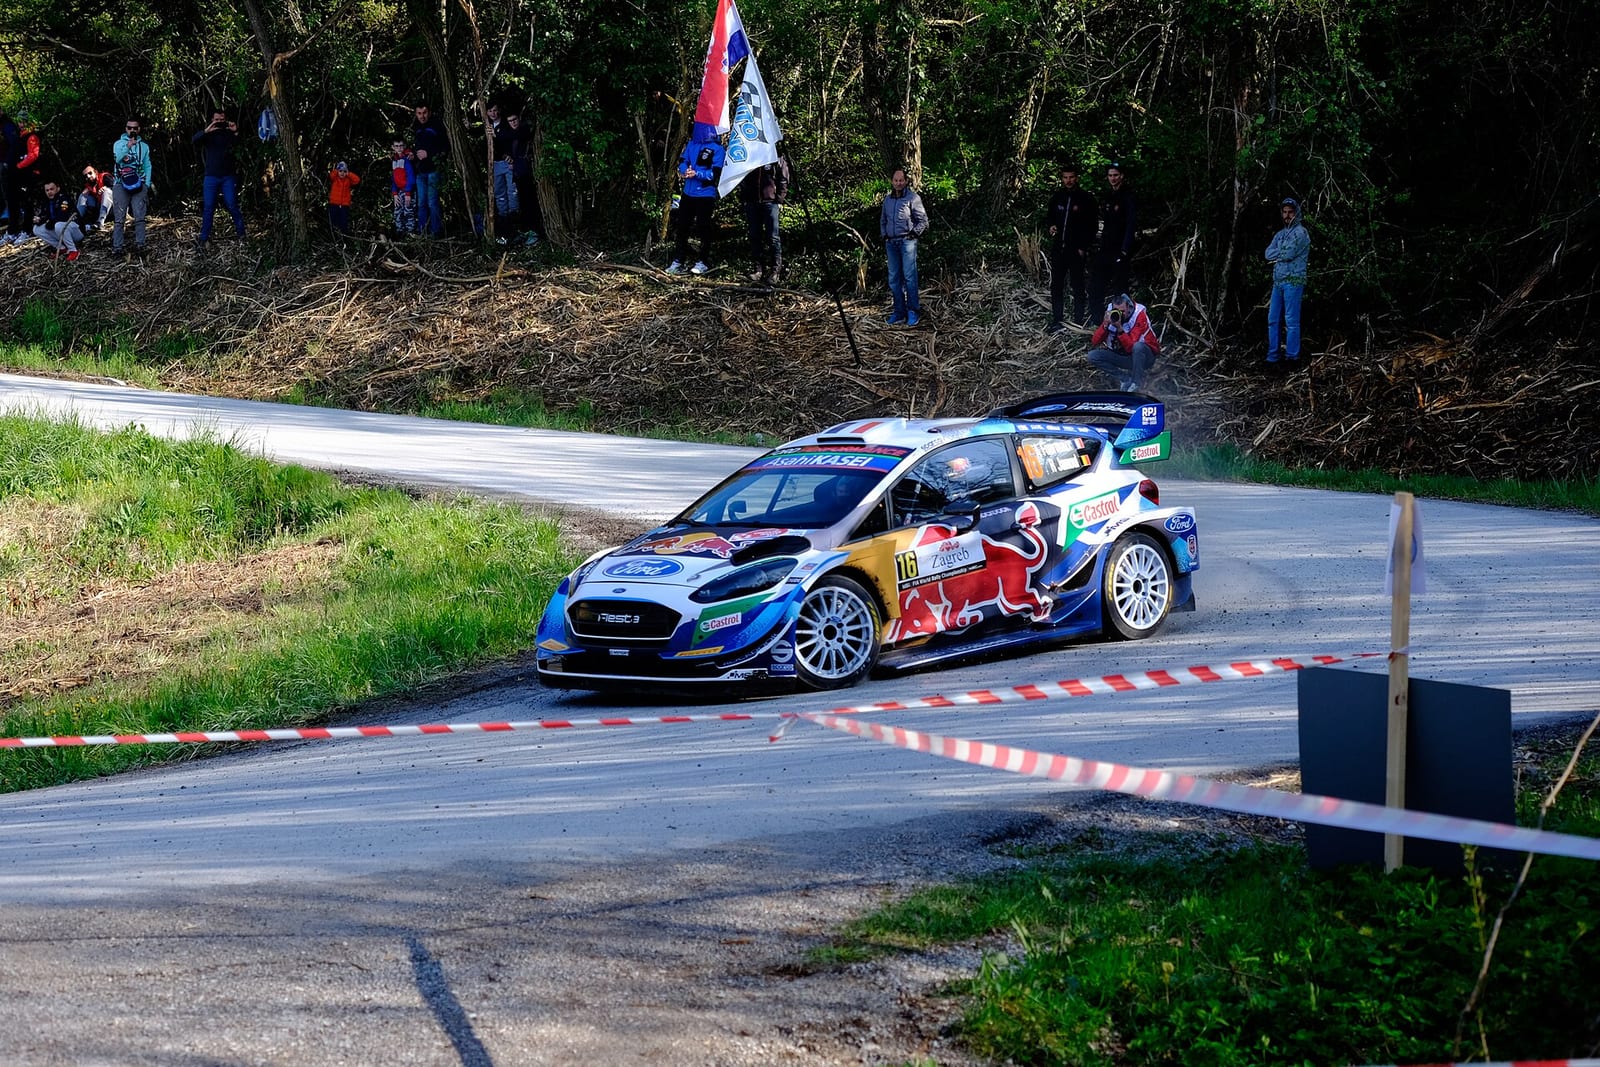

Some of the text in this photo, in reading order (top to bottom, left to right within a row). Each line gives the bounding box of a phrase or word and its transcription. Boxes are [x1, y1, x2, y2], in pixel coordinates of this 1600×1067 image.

[734, 95, 760, 142] UTO
[1141, 406, 1157, 417] RPJ
[762, 454, 874, 467] AsahiKASEI
[1136, 445, 1158, 459] Castrol
[1016, 444, 1044, 480] 16
[1083, 495, 1120, 522] Castrol
[1169, 515, 1191, 530] Ford
[896, 551, 918, 580] 16
[931, 547, 970, 569] Zagreb
[615, 559, 671, 576] Ford
[709, 615, 739, 629] Castrol
